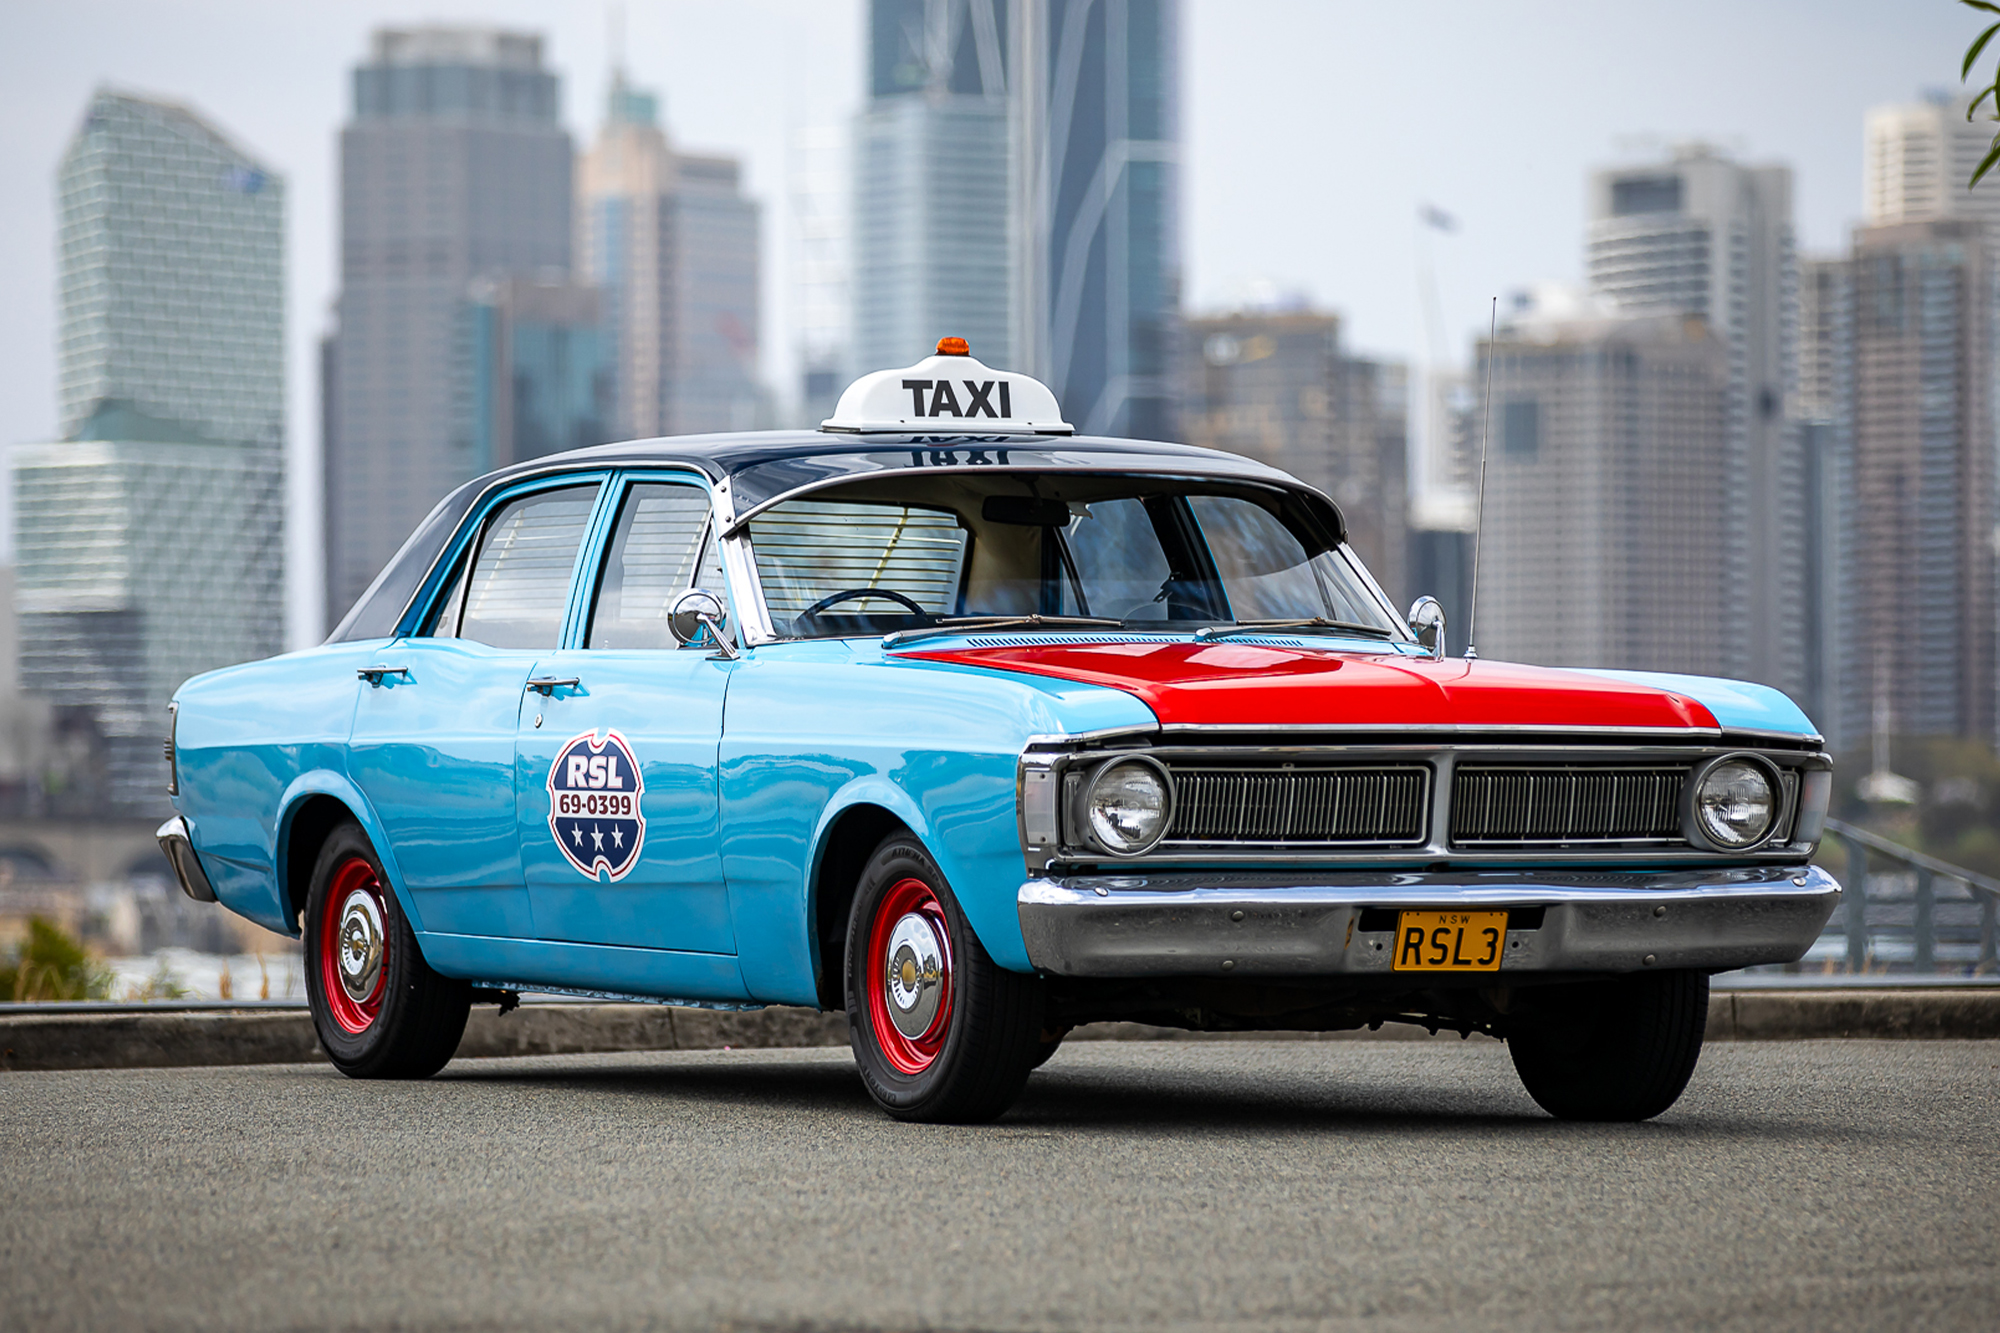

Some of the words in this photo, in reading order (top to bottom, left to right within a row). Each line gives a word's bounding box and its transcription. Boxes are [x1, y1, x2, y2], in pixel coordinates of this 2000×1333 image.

[902, 379, 1011, 418] TAXI
[567, 755, 623, 788] RSL
[559, 794, 631, 815] 69-0399
[1439, 915, 1471, 924] NSW
[1401, 927, 1499, 966] RSL3
